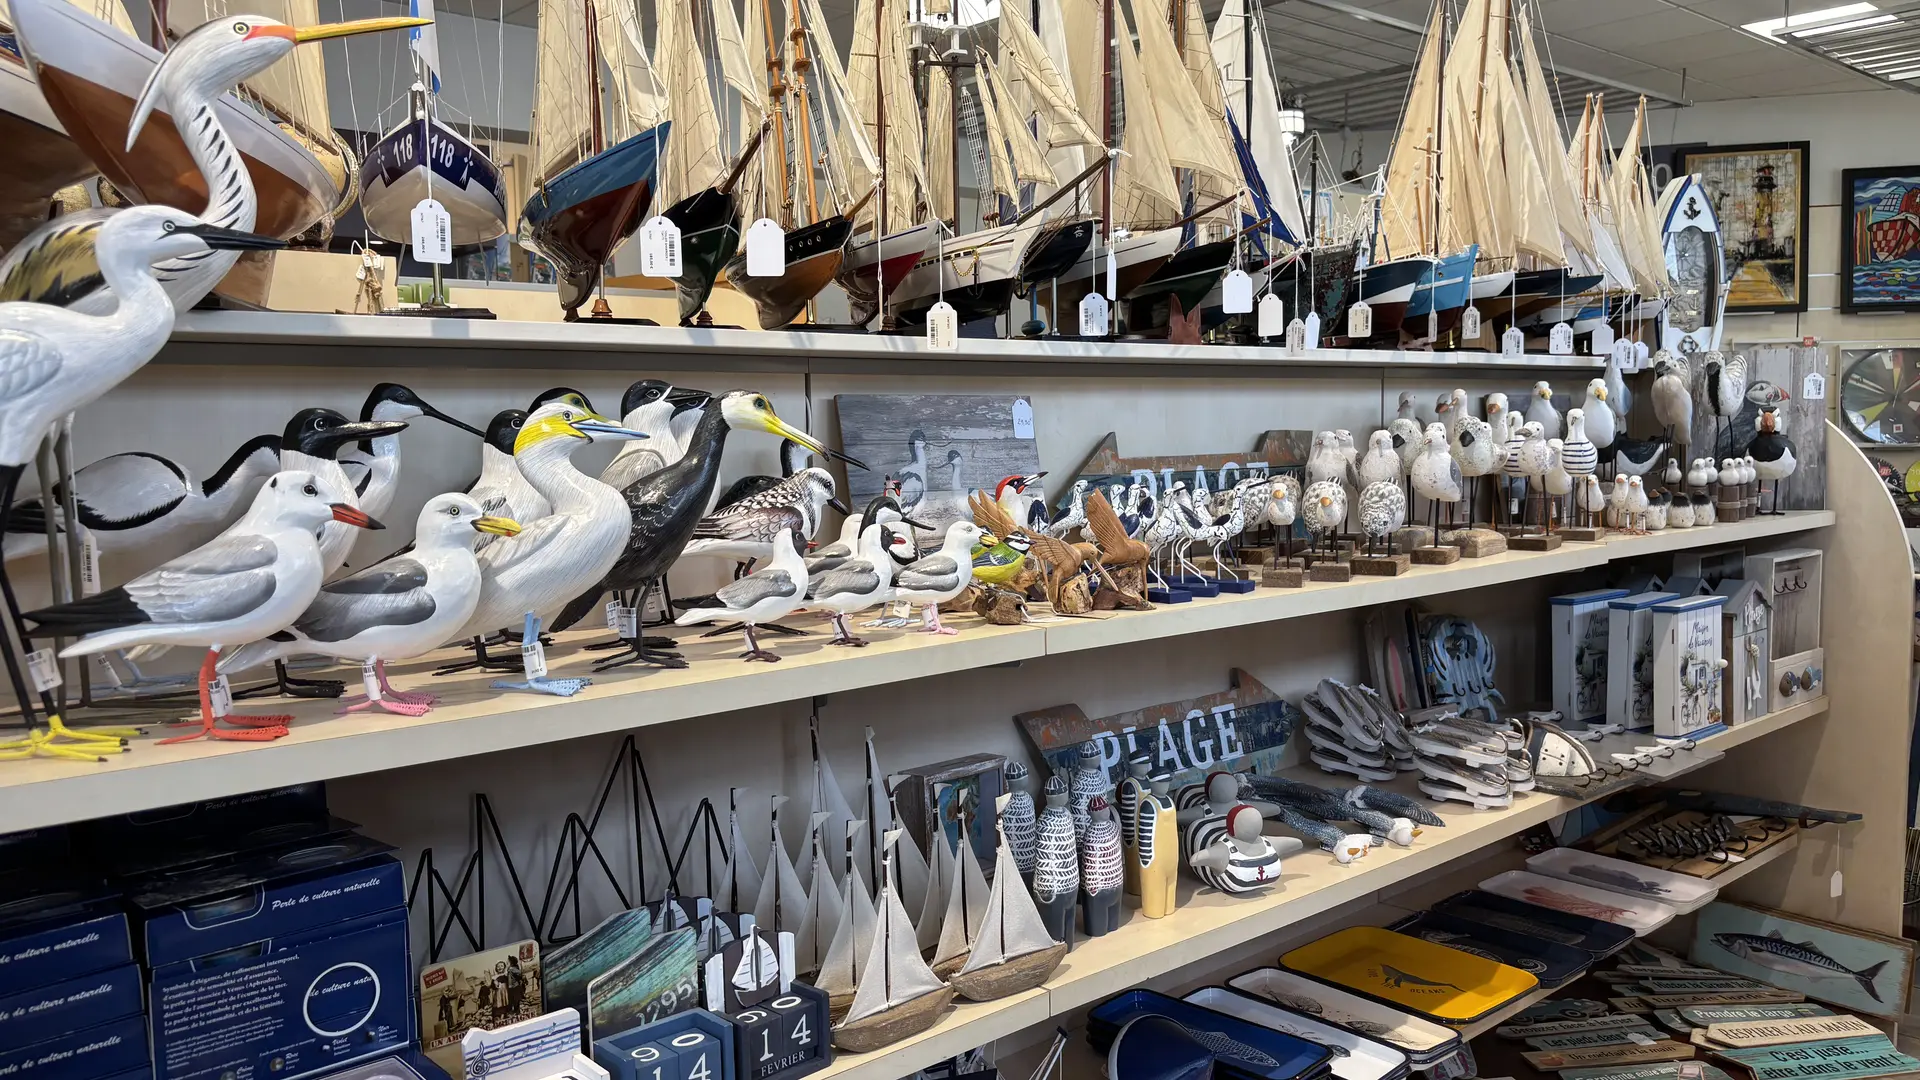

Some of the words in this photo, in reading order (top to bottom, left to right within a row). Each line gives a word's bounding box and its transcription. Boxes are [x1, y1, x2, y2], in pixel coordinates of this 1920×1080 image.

[393, 133, 413, 167] 118
[430, 133, 455, 168] 118
[1092, 703, 1244, 789] PLAGE
[272, 898, 296, 911] Perle
[298, 894, 310, 903] de
[312, 888, 342, 901] culture
[343, 878, 381, 893] naturelle
[14, 945, 51, 960] culture
[53, 932, 100, 951] naturelle
[322, 982, 351, 994] culture
[353, 976, 373, 985] natu
[12, 1007, 26, 1018] de
[28, 997, 65, 1013] culture
[67, 983, 113, 1002] naturelle
[1692, 1009, 1745, 1019] Prendre
[1747, 1008, 1761, 1018] le
[1763, 1008, 1795, 1020] large
[1509, 1024, 1557, 1035] Bronzer
[1560, 1020, 1586, 1030] face
[1595, 1019, 1609, 1028] la
[1610, 1018, 1634, 1027] mer
[1542, 1037, 1566, 1048] Les
[1567, 1034, 1596, 1047] pieds
[1596, 1031, 1623, 1044] dans
[1718, 1023, 1783, 1041] RESPIRER
[1818, 1019, 1870, 1033] MARIN
[21, 1059, 35, 1069] de
[37, 1049, 74, 1065] culture
[76, 1035, 122, 1054] naturelle
[761, 1050, 806, 1077] FEVRIER
[1770, 1047, 1813, 1063] C'est
[1812, 1043, 1868, 1060] juste...
[1762, 1063, 1797, 1079] être
[1799, 1061, 1835, 1076] dans
[1842, 1058, 1857, 1072] le
[1855, 1055, 1892, 1069] vent
